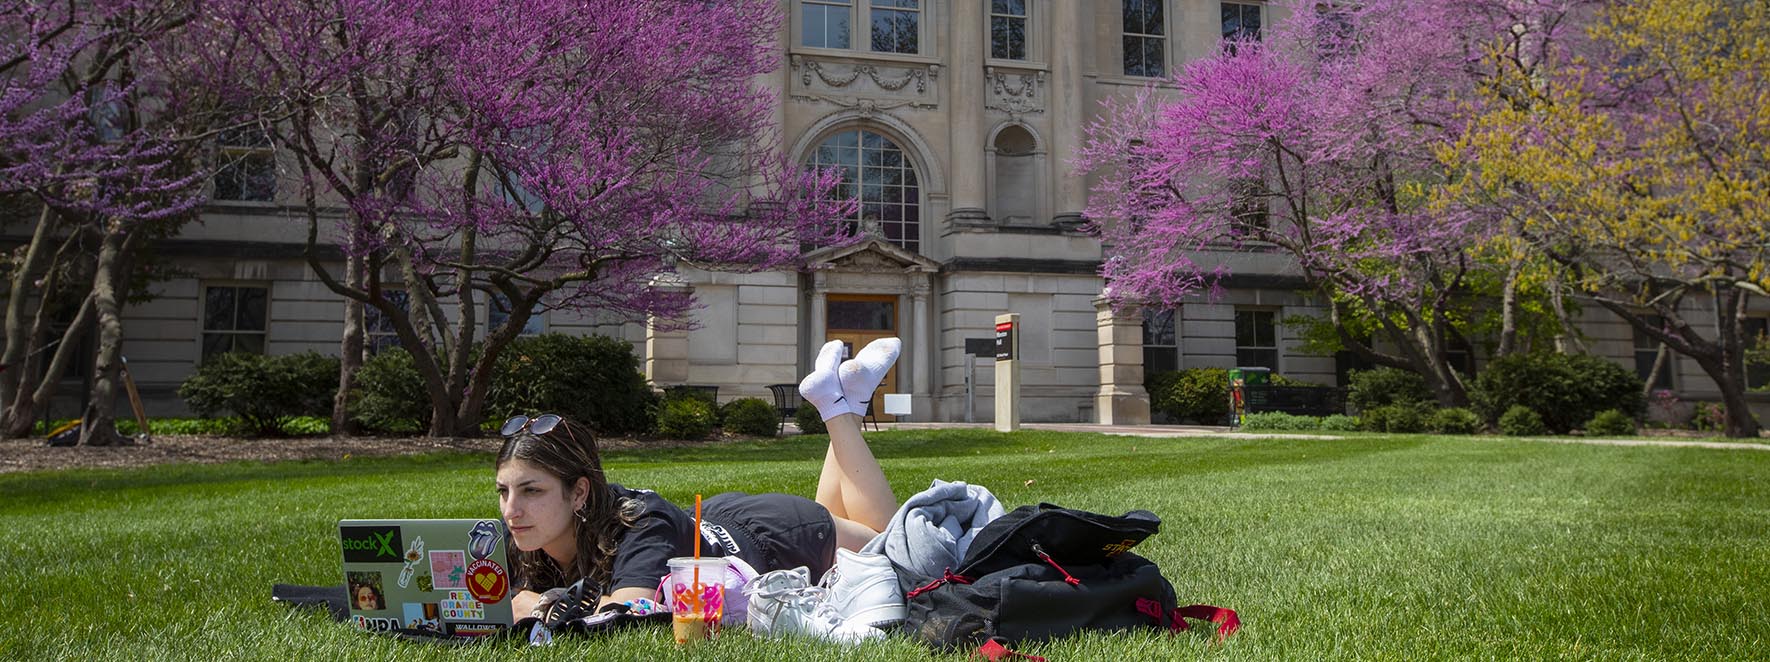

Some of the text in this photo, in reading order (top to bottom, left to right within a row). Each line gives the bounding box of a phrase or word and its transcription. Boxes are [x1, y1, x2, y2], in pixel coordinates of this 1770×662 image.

[343, 529, 397, 557] stockX
[467, 560, 503, 576] VACCINATED
[450, 591, 471, 600] REX
[442, 601, 482, 609] ORANGE
[443, 609, 483, 618] COUNTY
